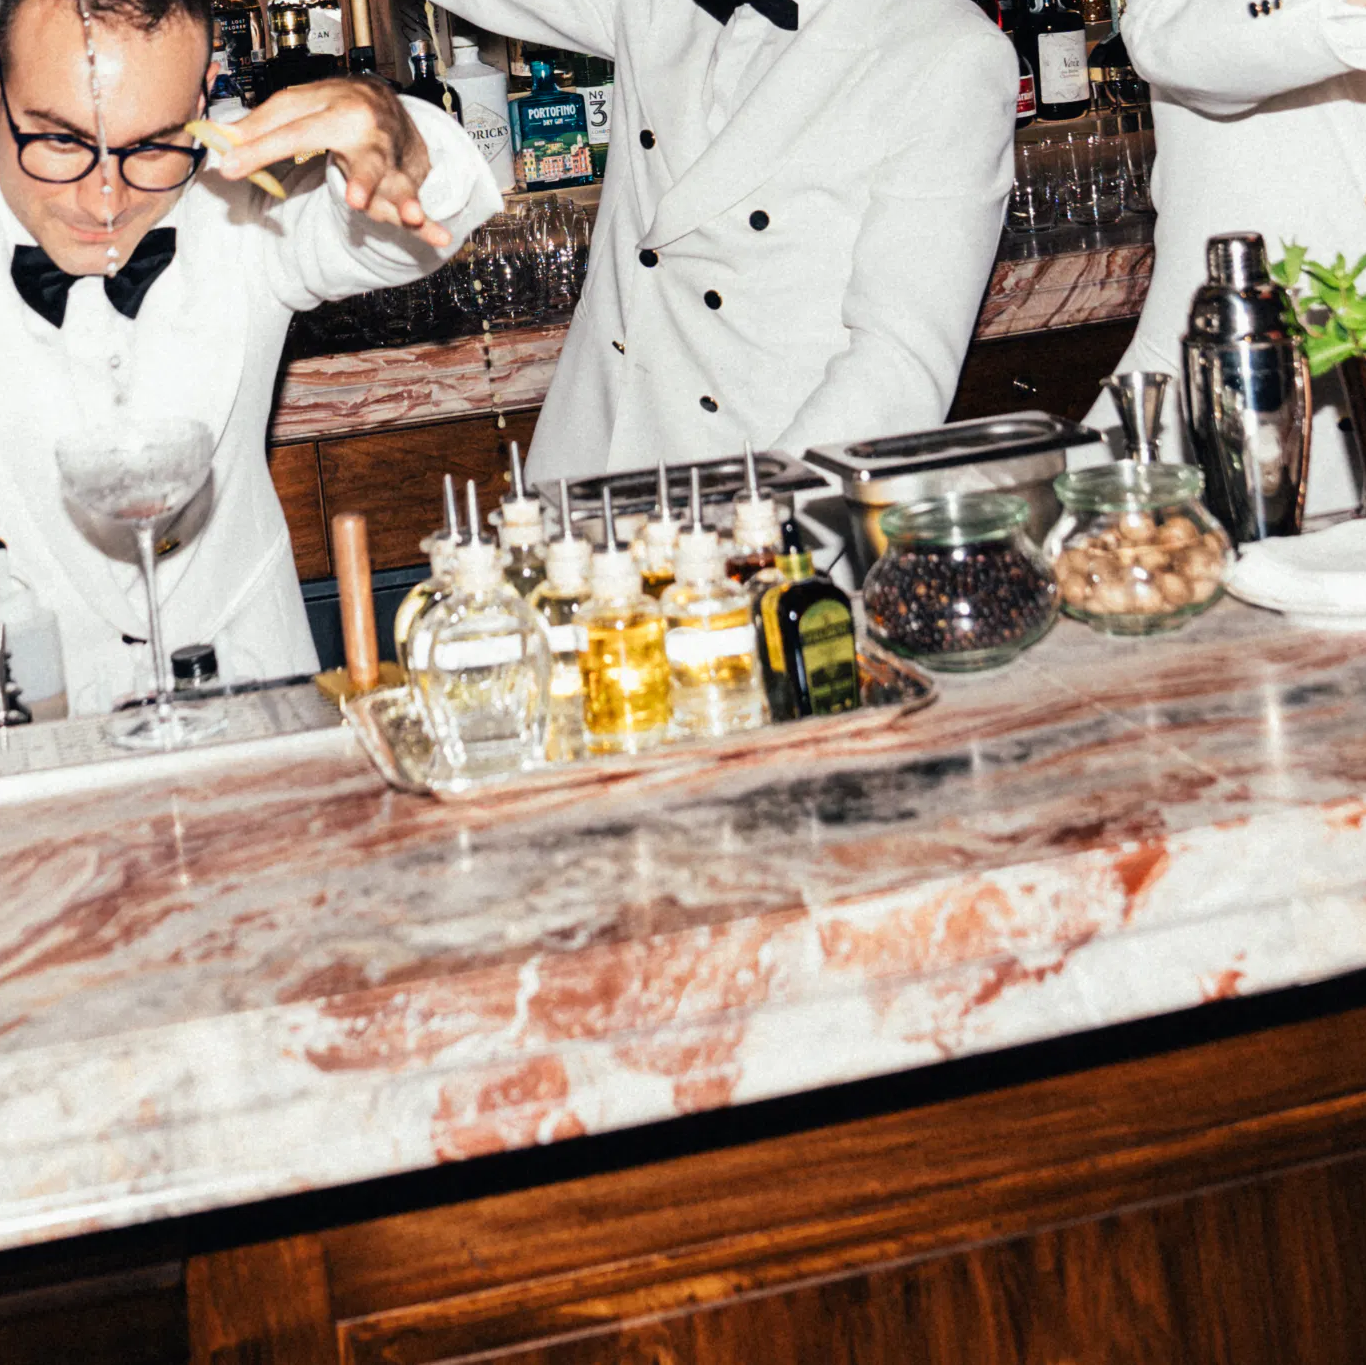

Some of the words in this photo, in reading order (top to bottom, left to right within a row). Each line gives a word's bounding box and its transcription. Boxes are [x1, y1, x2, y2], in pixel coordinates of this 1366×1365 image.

[528, 104, 576, 121] PORTOFINO
[589, 100, 608, 127] 3
[542, 118, 553, 127] DRY
